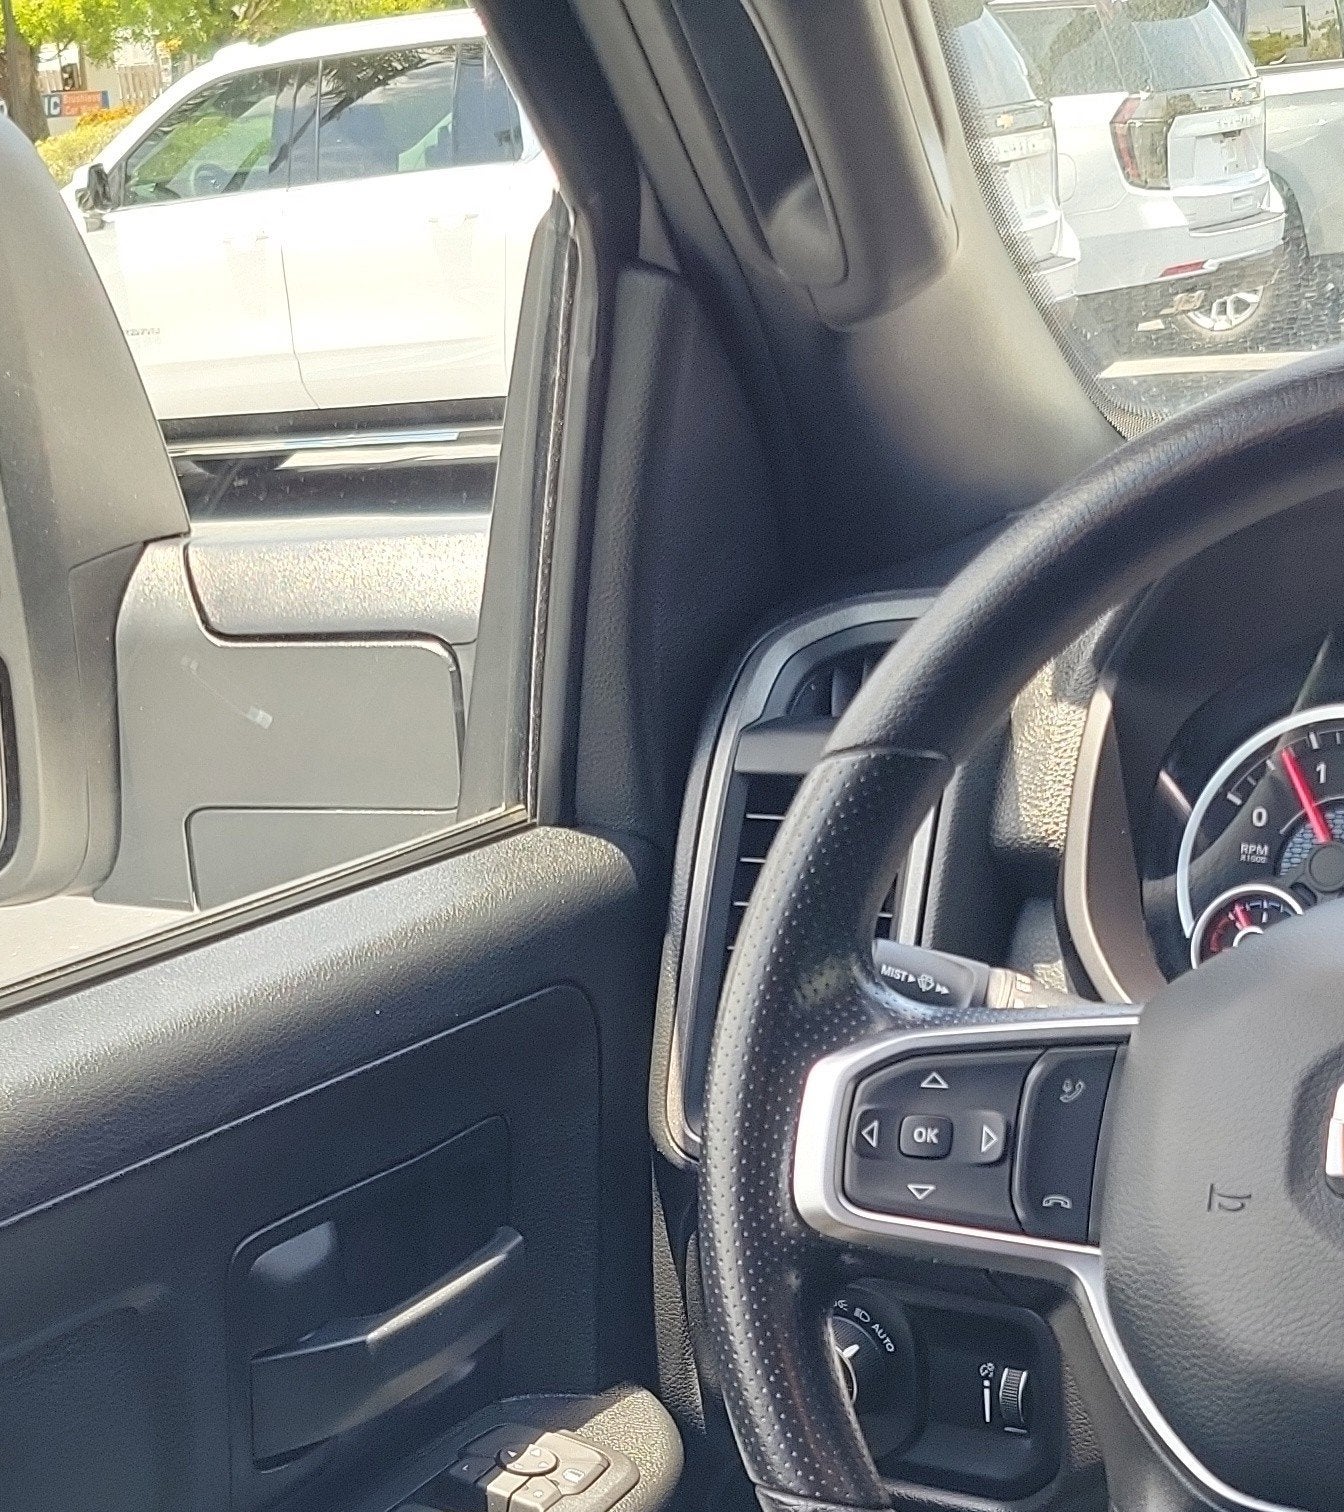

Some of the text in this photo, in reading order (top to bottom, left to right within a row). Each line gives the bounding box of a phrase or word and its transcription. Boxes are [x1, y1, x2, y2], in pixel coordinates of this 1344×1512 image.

[1316, 761, 1327, 784] 1
[1251, 806, 1268, 827] 0
[1240, 842, 1269, 856] RPM
[880, 964, 907, 982] MIST
[913, 1128, 938, 1144] OK
[871, 1323, 895, 1353] AUTO
